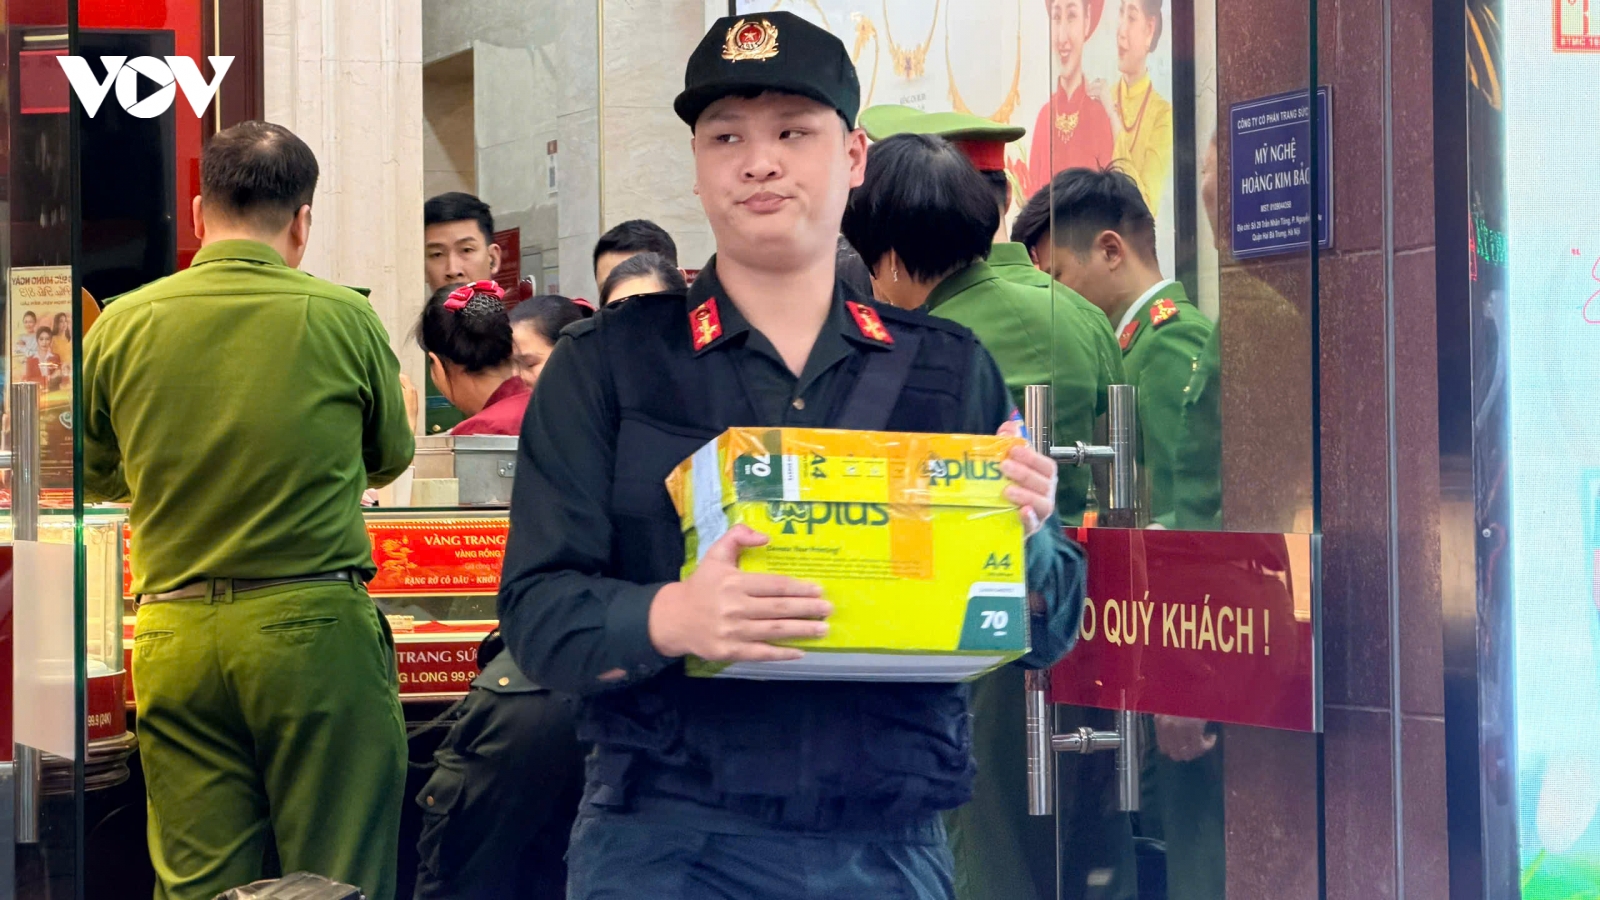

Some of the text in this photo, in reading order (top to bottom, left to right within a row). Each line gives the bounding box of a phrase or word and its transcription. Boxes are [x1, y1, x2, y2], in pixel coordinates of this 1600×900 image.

[1252, 117, 1258, 127] TY
[1280, 108, 1297, 120] TRANG
[1254, 136, 1296, 165] MỸ NGHỆ
[1241, 171, 1273, 195] HOÀNG
[1274, 170, 1292, 190] KIM
[810, 451, 828, 479] A4
[944, 451, 1003, 487] plus
[424, 533, 505, 546] VÀNG TRANG
[454, 548, 477, 559] VÀNG
[478, 547, 501, 559] RỒNG
[983, 552, 1012, 570] A4
[404, 576, 426, 587] RẠNG
[980, 610, 1009, 630] 70
[1077, 590, 1270, 656] O QUÝ KHÁCH !
[397, 647, 478, 664] TRANG SỨ
[398, 672, 408, 683] G
[411, 671, 448, 683] LONG
